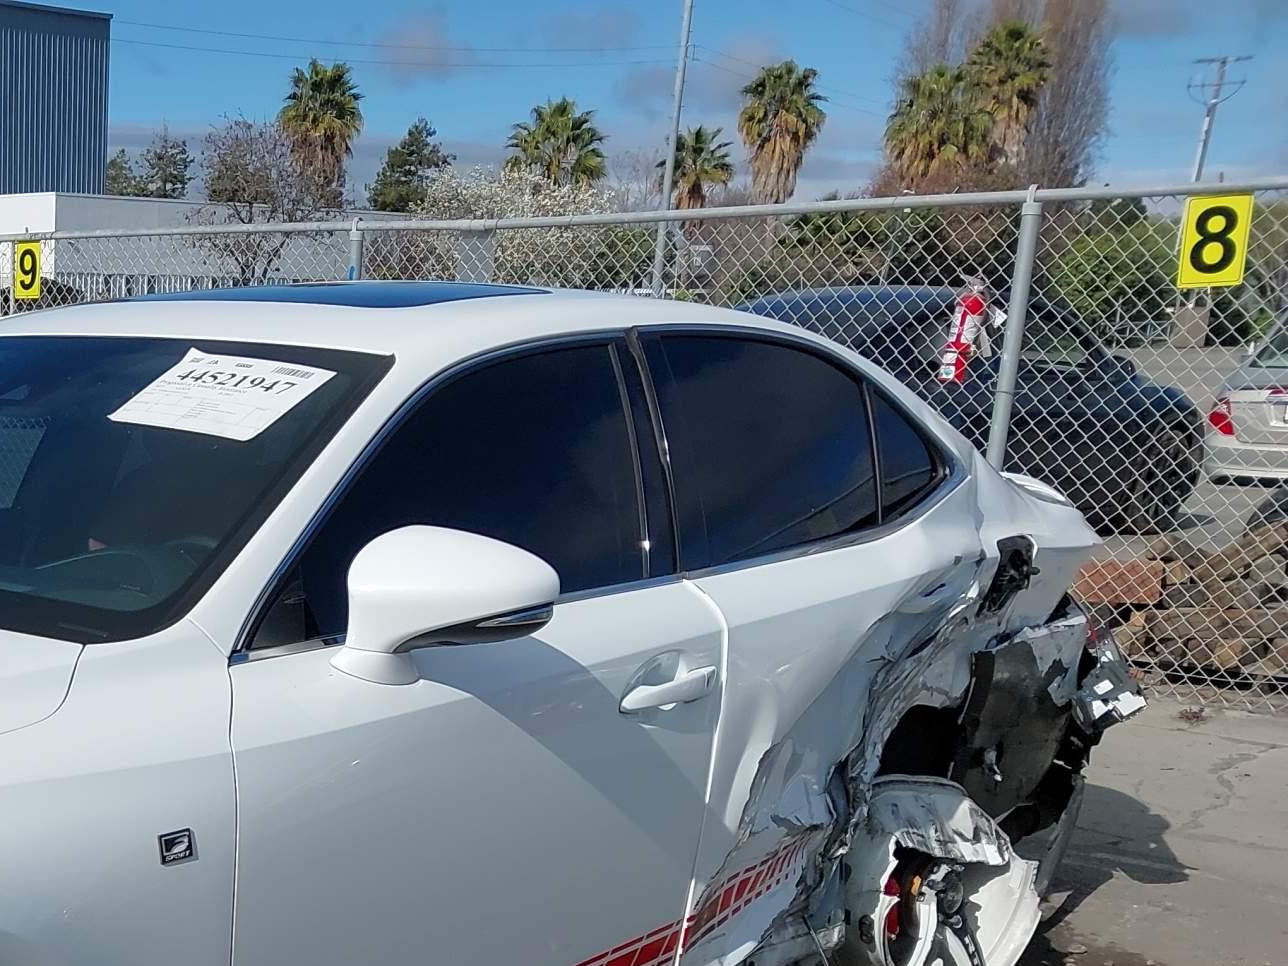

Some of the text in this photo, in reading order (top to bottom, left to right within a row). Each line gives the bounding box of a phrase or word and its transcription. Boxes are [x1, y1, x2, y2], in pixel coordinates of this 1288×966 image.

[1190, 205, 1239, 274] 8
[19, 249, 37, 290] 9
[176, 368, 297, 395] 44521947
